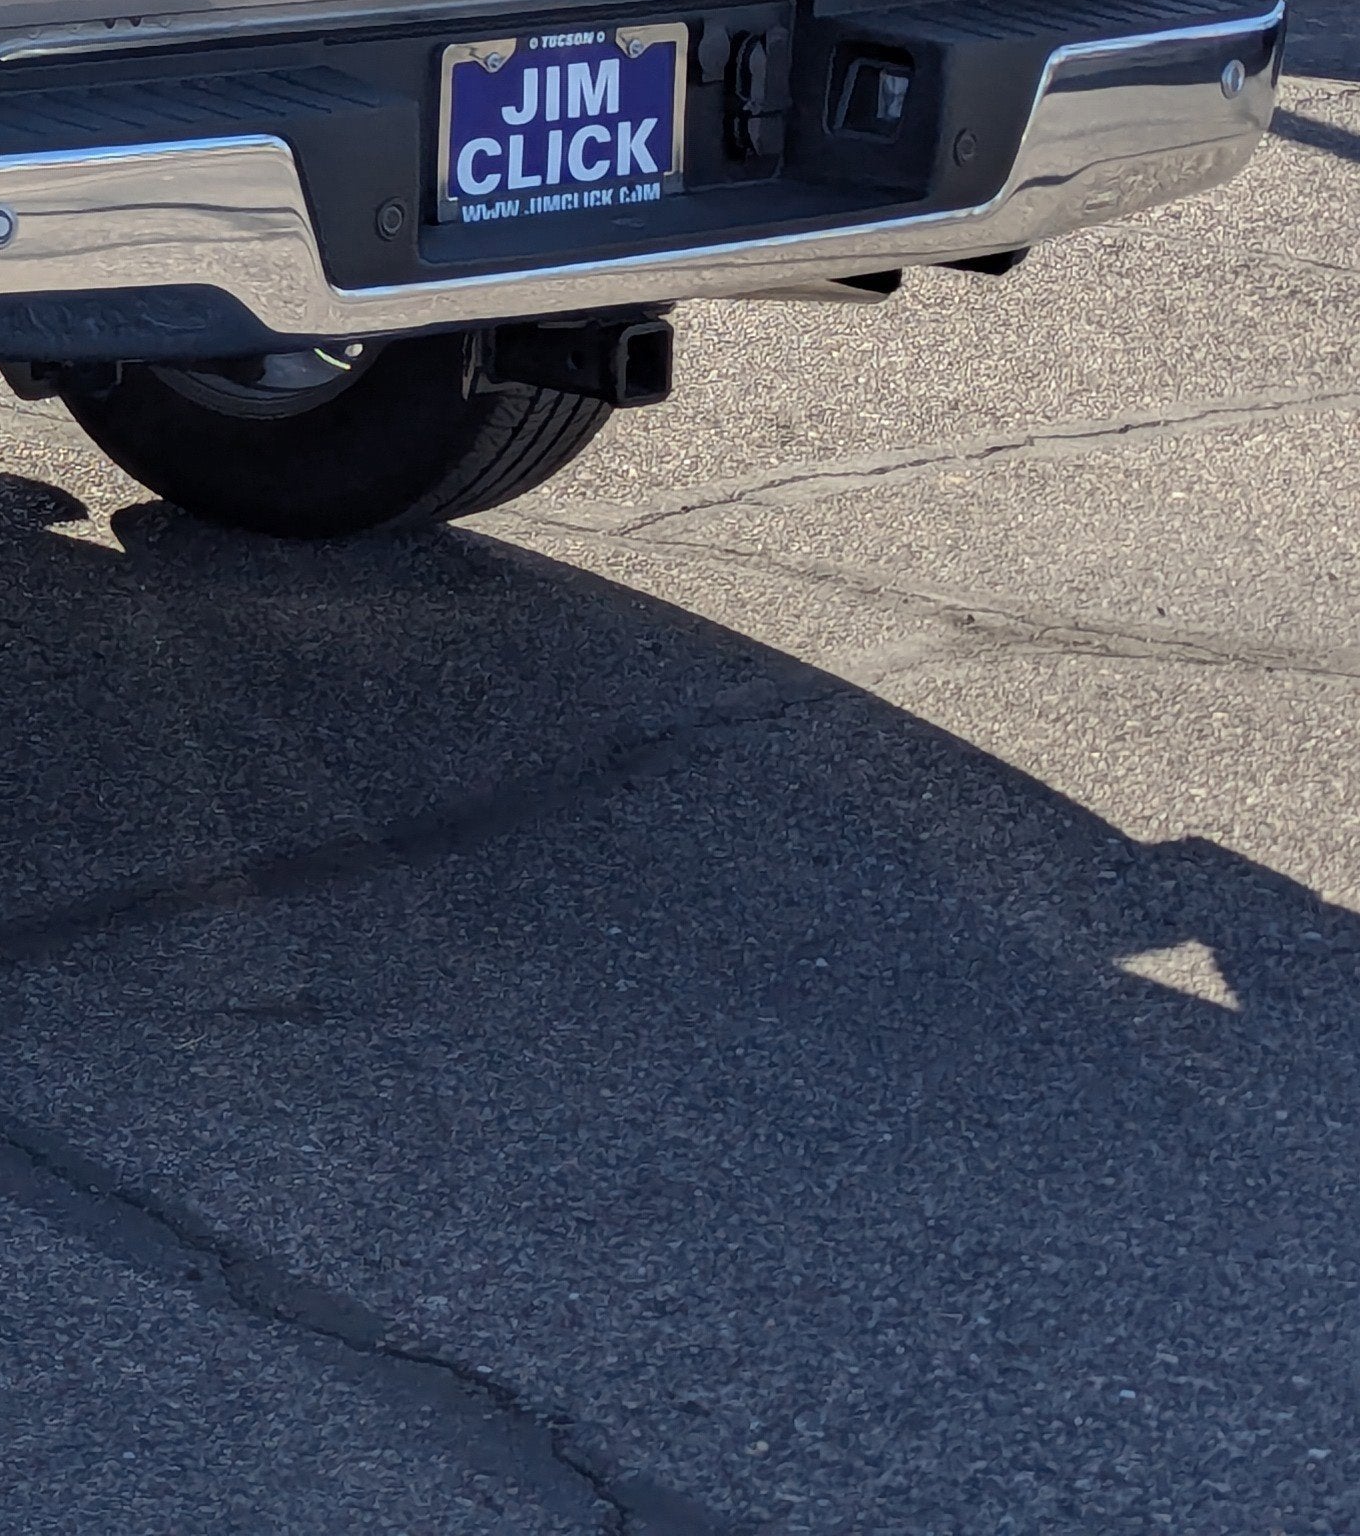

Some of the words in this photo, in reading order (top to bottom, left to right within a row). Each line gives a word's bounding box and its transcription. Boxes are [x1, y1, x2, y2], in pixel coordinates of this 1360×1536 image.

[541, 31, 595, 49] TUCSON
[501, 57, 621, 126] JIM
[456, 117, 660, 196] CLICK
